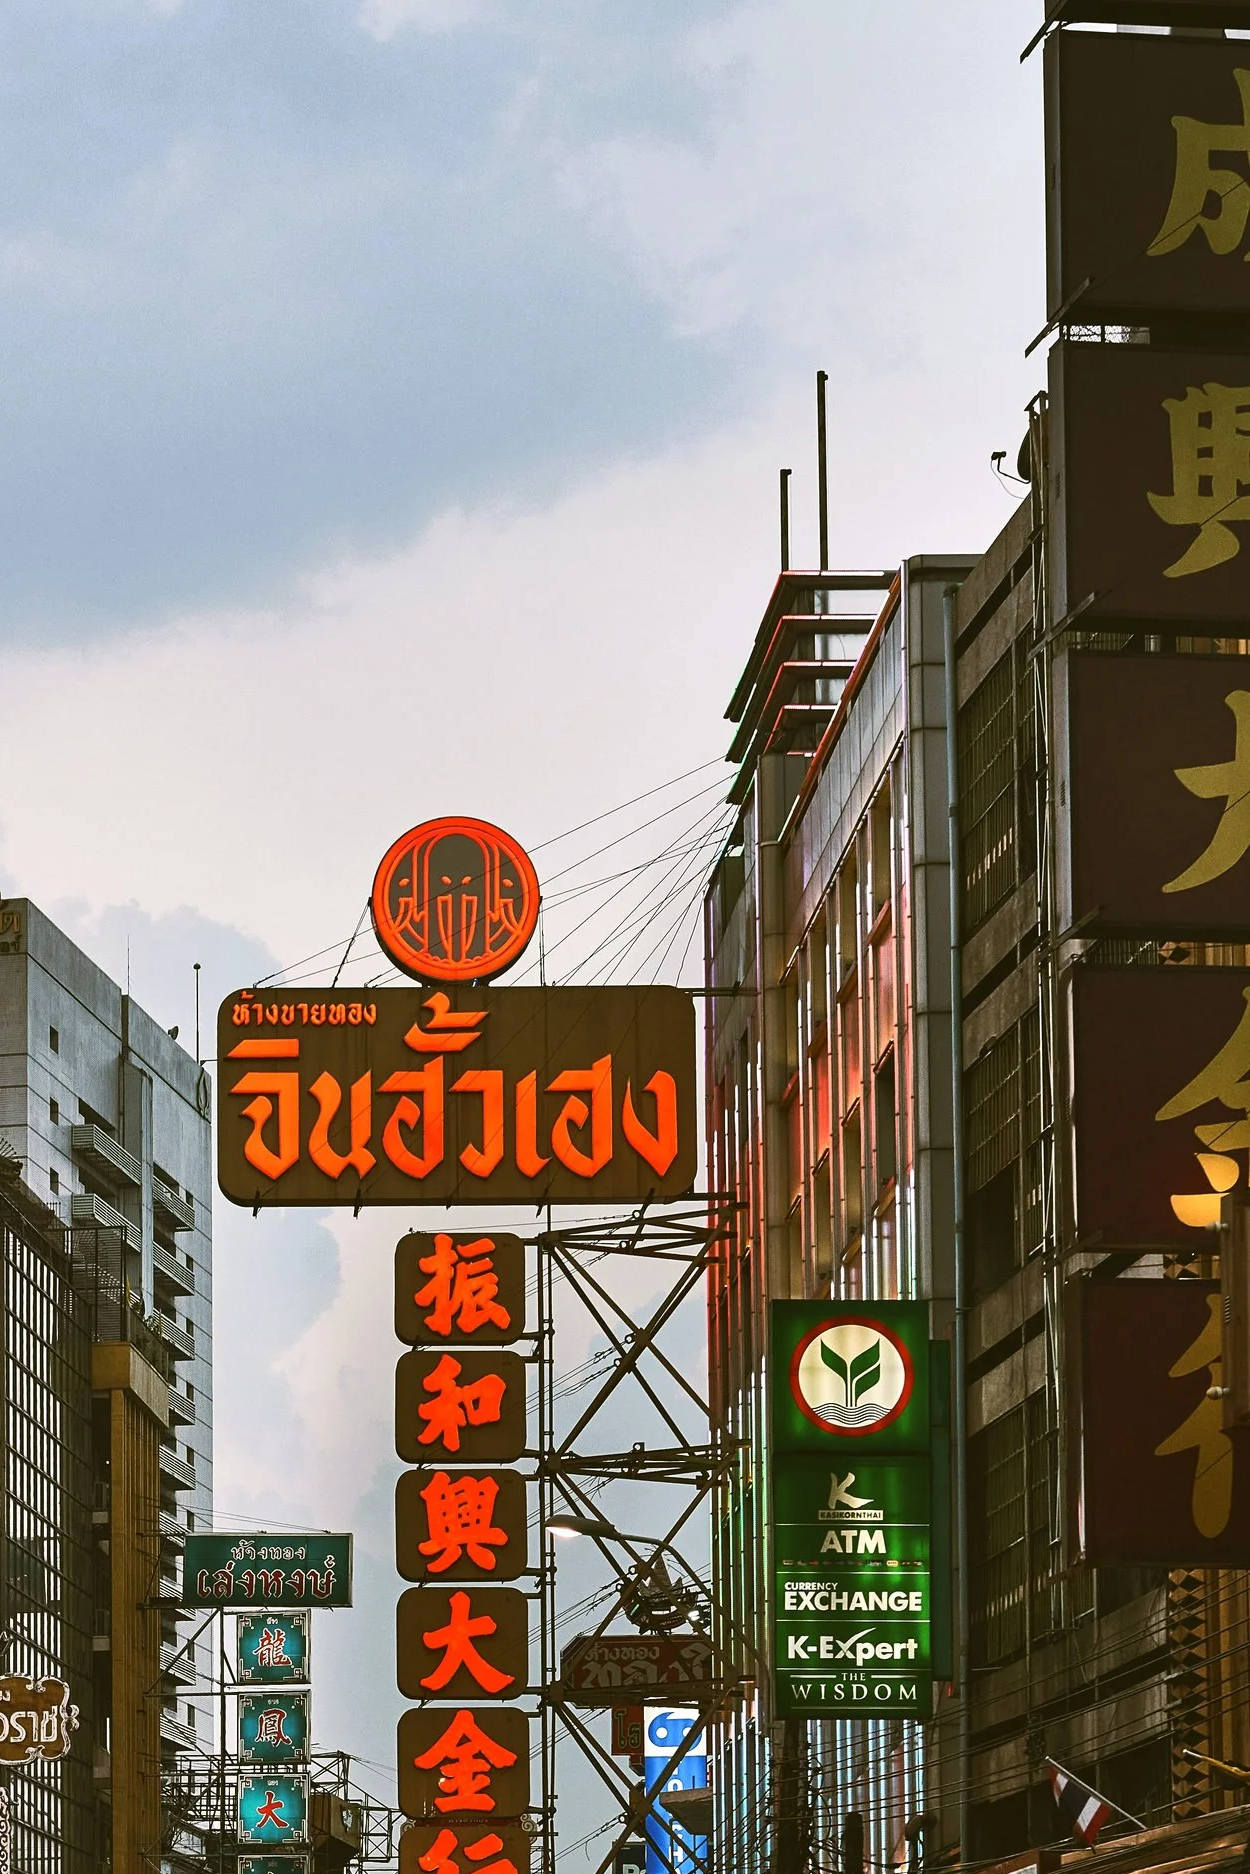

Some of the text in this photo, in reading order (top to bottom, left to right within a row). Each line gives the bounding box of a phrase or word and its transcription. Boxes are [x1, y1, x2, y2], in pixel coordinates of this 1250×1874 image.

[231, 992, 377, 1027] ห้างขายทอง
[225, 992, 678, 1180] จินฮั้วเฮง
[821, 1511, 882, 1519] KASIKORNTHAI
[230, 1539, 306, 1560] ห้างทอง
[820, 1529, 887, 1553] ATM
[784, 1581, 838, 1591] CURRENCY
[784, 1591, 923, 1612] EXCHANGE
[787, 1627, 918, 1667] K-Expert
[841, 1673, 866, 1681] THE
[791, 1683, 917, 1700] WISDOM
